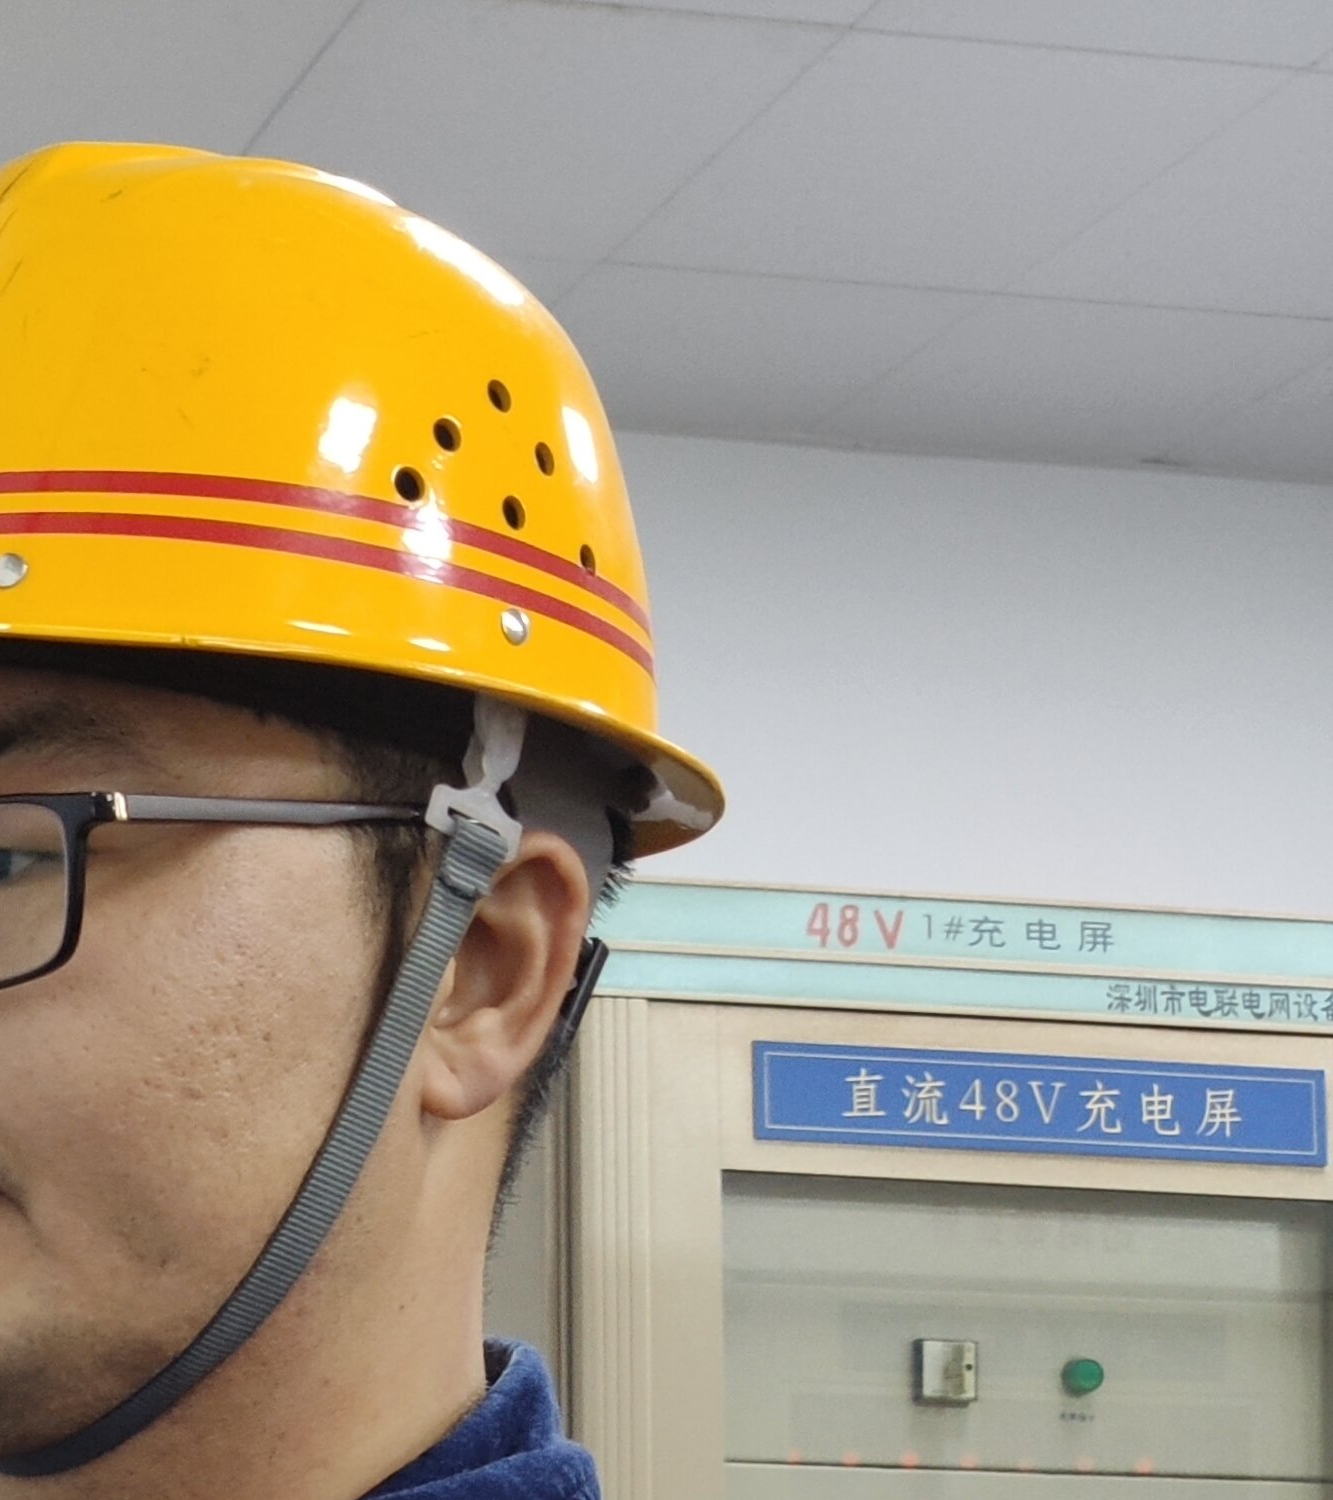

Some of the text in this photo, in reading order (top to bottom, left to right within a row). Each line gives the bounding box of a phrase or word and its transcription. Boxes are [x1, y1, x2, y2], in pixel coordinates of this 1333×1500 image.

[806, 902, 1115, 953] 48V 1#充电屏
[841, 1067, 1243, 1137] 直流48V充电屏
